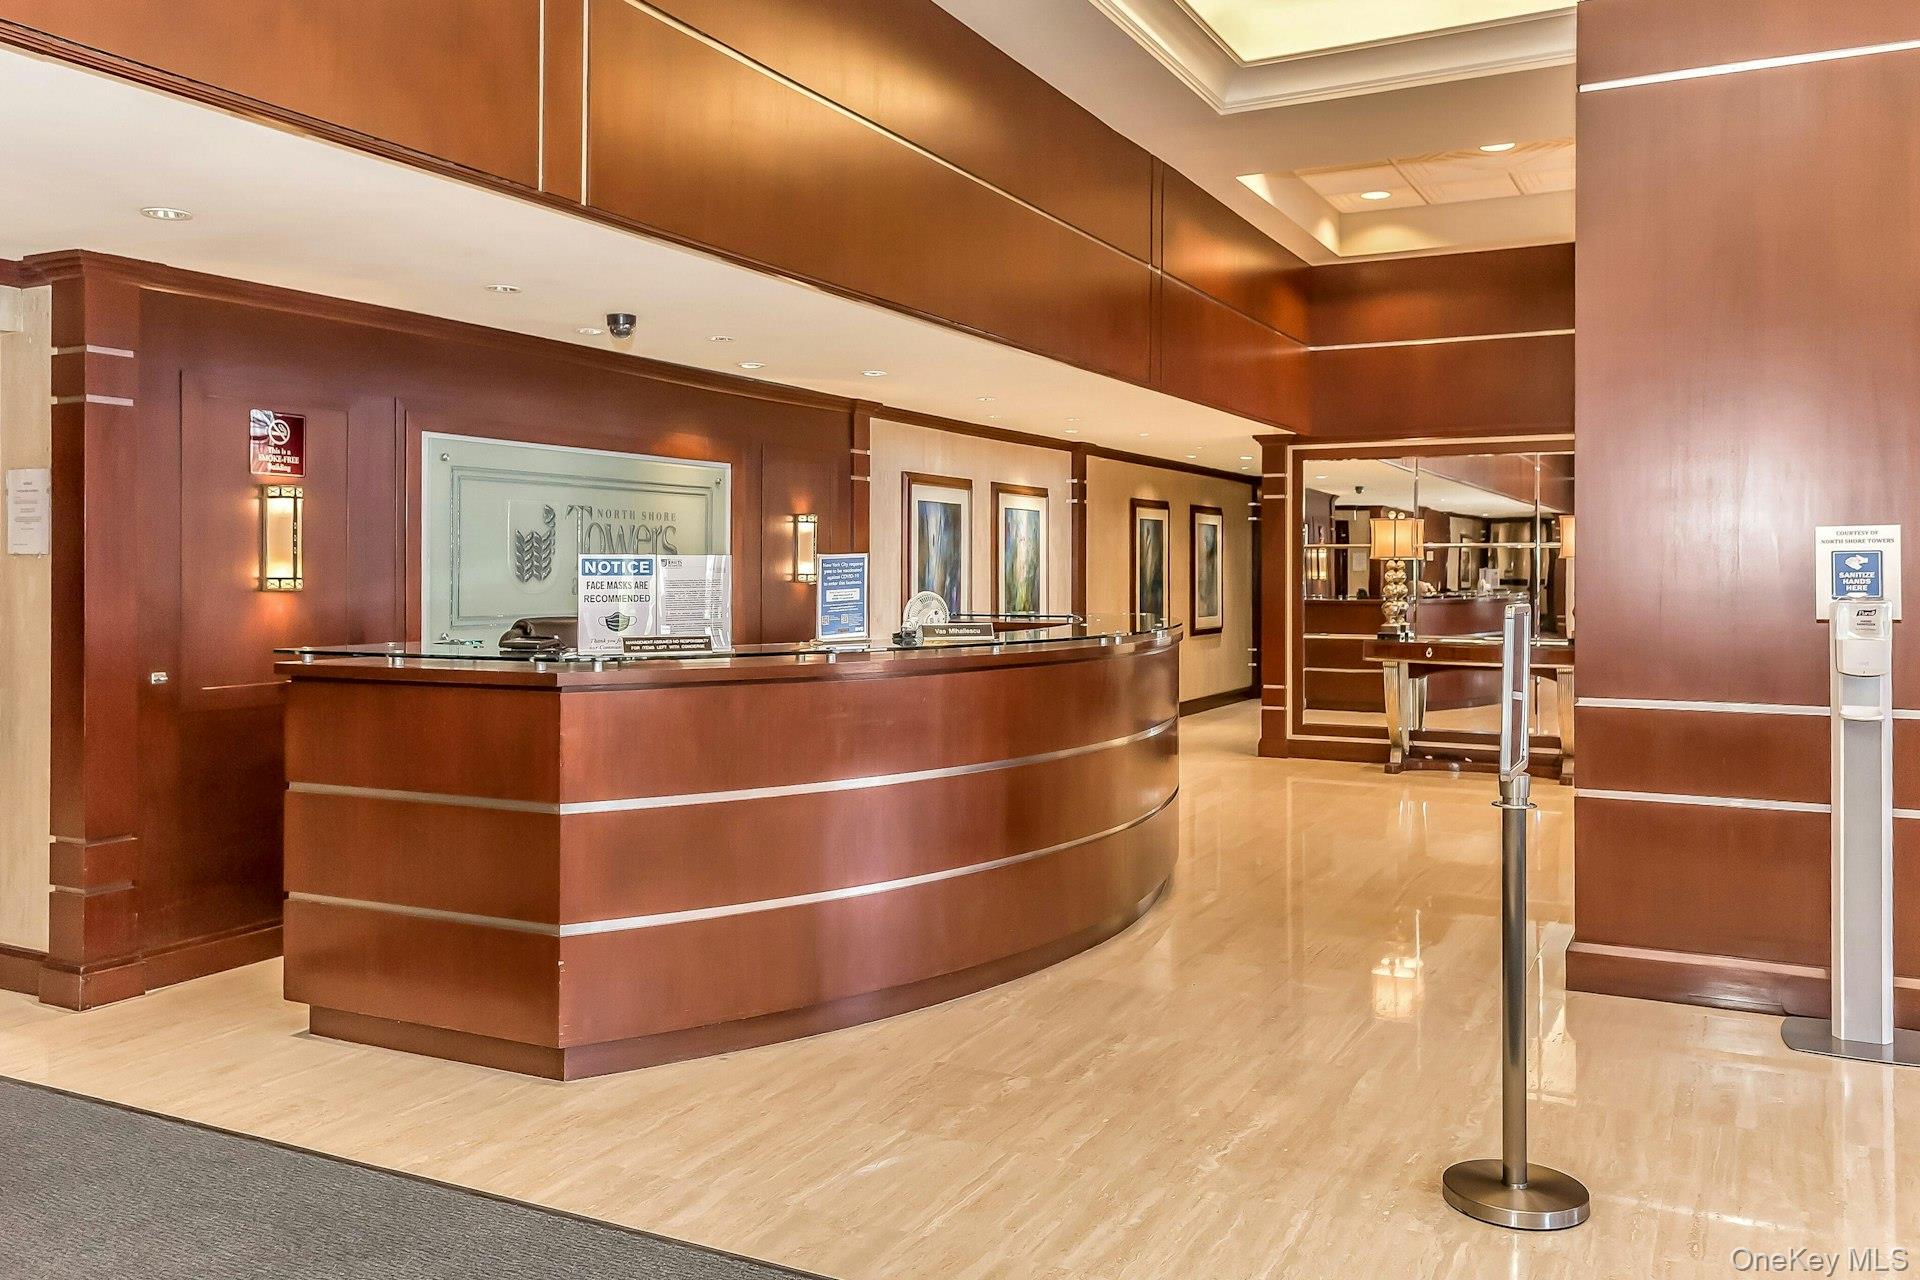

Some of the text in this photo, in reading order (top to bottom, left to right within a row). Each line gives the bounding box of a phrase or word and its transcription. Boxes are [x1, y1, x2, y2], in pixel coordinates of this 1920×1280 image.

[258, 454, 299, 464] SMOKE-FREE
[597, 508, 677, 522] NORTH SHORE
[565, 504, 678, 554] Towers
[584, 560, 650, 574] NOTICE
[586, 580, 605, 590] FACE
[606, 580, 632, 590] MASKS
[634, 580, 648, 590] ARE
[583, 594, 651, 603] RECOMMENDED
